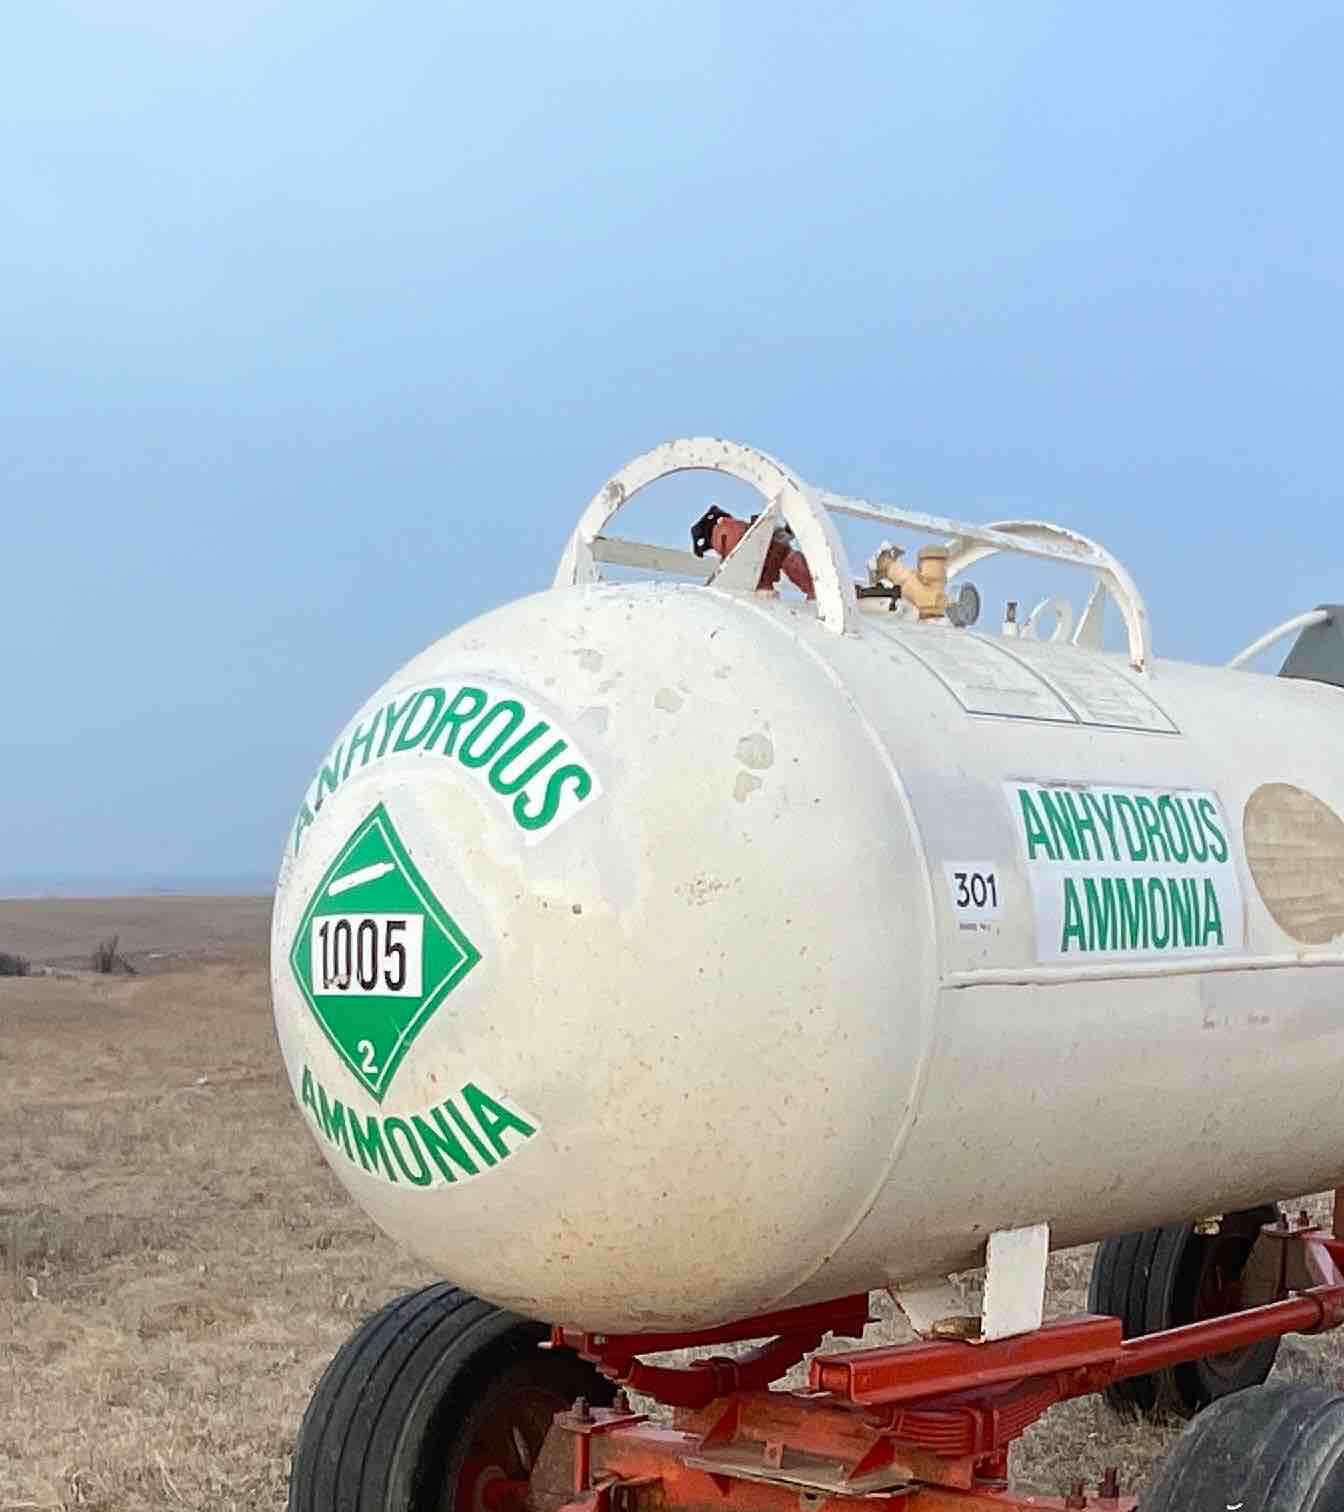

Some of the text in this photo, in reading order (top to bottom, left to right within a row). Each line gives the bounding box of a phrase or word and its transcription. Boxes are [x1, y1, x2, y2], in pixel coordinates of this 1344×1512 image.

[294, 686, 592, 858] ANHYDROUS
[1018, 788, 1229, 864] ANHYDROUS
[954, 872, 998, 908] 301
[1061, 877, 1225, 953] AMMONIA
[318, 918, 407, 991] 1005
[358, 1040, 378, 1074] 2
[302, 1065, 537, 1186] AMMONIA
